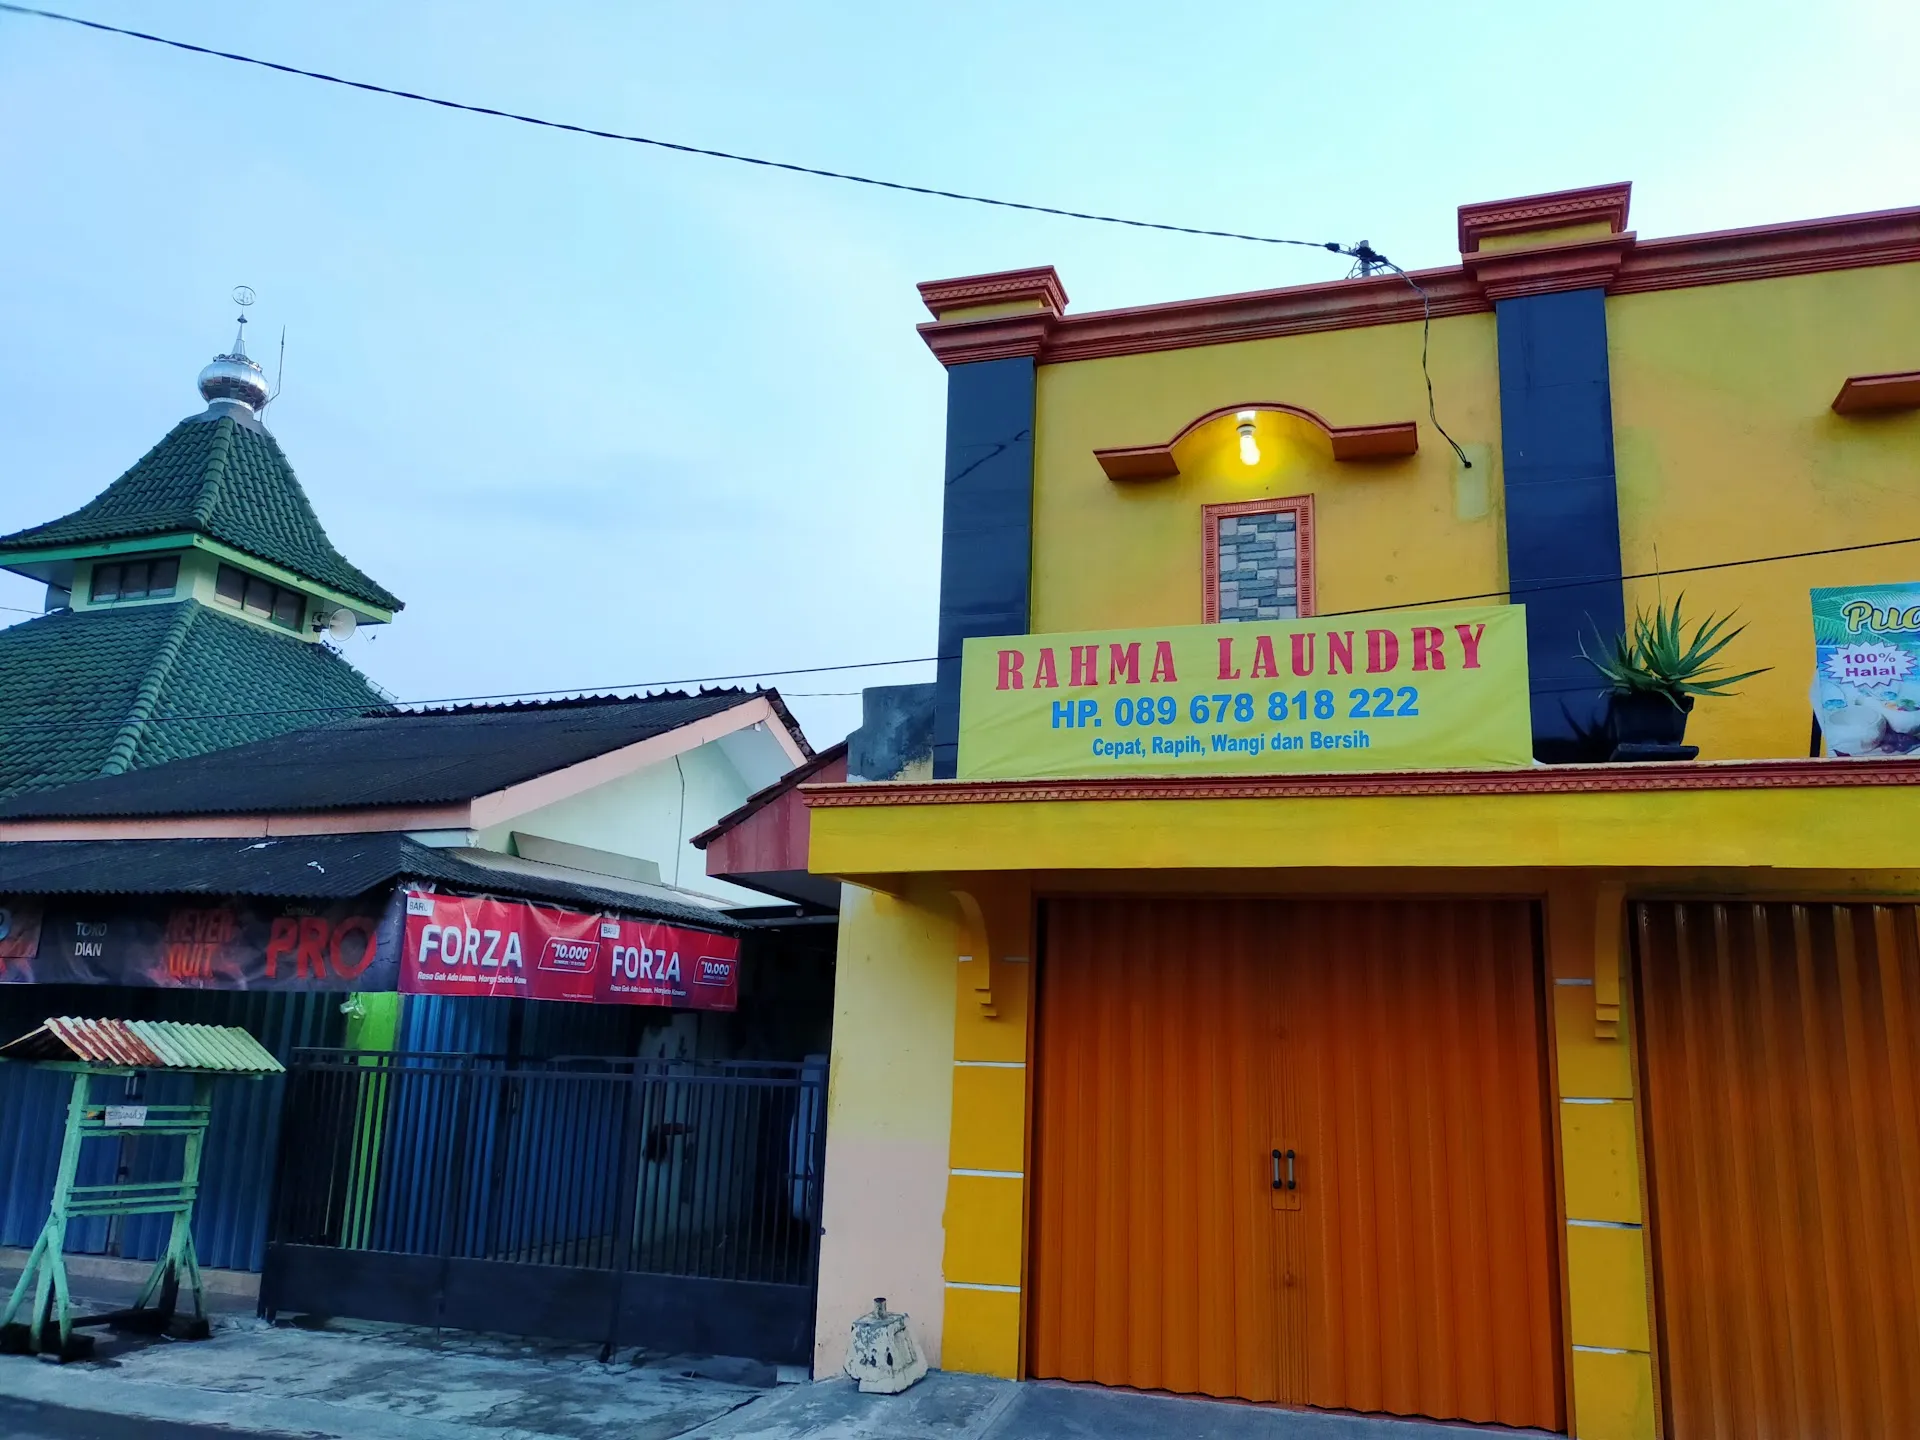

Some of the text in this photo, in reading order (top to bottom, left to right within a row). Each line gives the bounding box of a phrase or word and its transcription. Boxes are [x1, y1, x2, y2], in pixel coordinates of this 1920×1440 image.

[996, 624, 1487, 690] RAHMA LAUNDRY
[1842, 652, 1896, 664] 100%
[1845, 666, 1896, 677] Halal
[1051, 685, 1420, 730] HP. 089 678 818 222
[1092, 729, 1370, 759] Cepat, Rapih, Wangi dan Bersih
[75, 921, 107, 937] TOKO
[418, 923, 524, 968] FORZA
[74, 941, 103, 957] DIAN
[265, 915, 378, 980] PRO
[611, 945, 681, 983] FORZA
